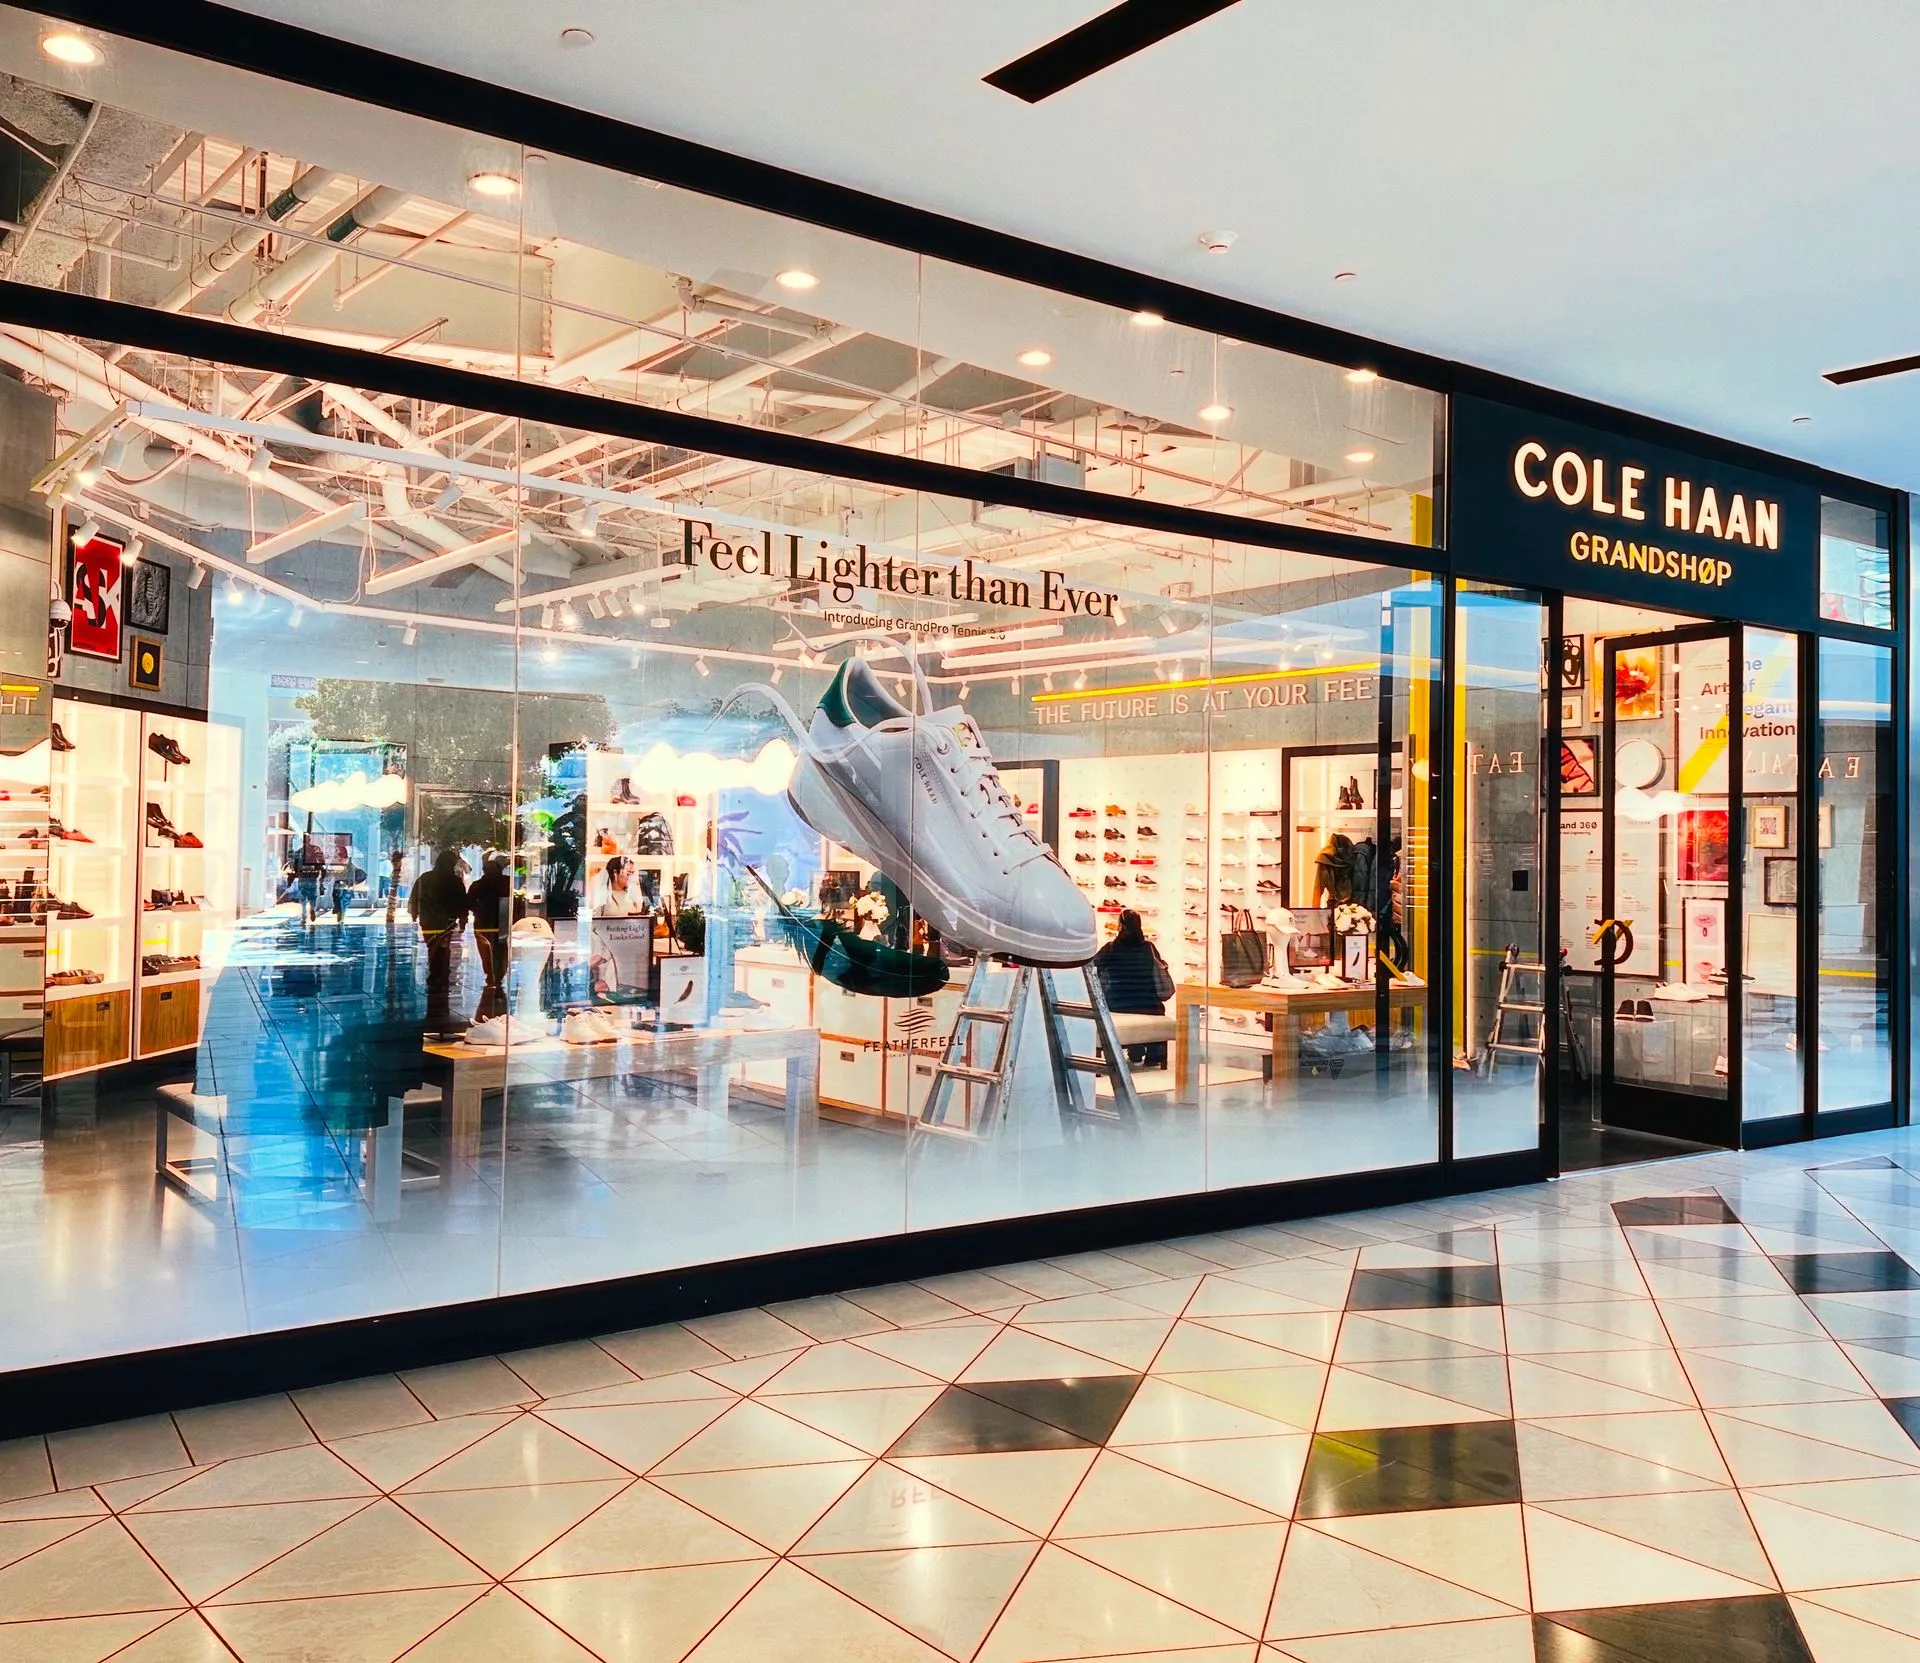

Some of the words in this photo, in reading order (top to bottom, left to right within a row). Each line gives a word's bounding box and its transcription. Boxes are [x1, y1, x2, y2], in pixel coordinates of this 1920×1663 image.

[1514, 442, 1645, 520] COLE
[1665, 477, 1778, 550] HAAN
[678, 518, 774, 576] Feel
[785, 534, 940, 603] Lighter
[948, 559, 1032, 608] than
[1039, 569, 1119, 618] Ever
[1570, 531, 1732, 587] GRANDSHØP
[824, 610, 893, 631] Introducing
[1035, 704, 1071, 725] THE
[1081, 697, 1158, 722] FUTURE
[1169, 693, 1189, 715] IS
[1202, 690, 1230, 712] AT
[1243, 683, 1309, 708] YOUR
[863, 1036, 963, 1053] FEATHERFEEL
